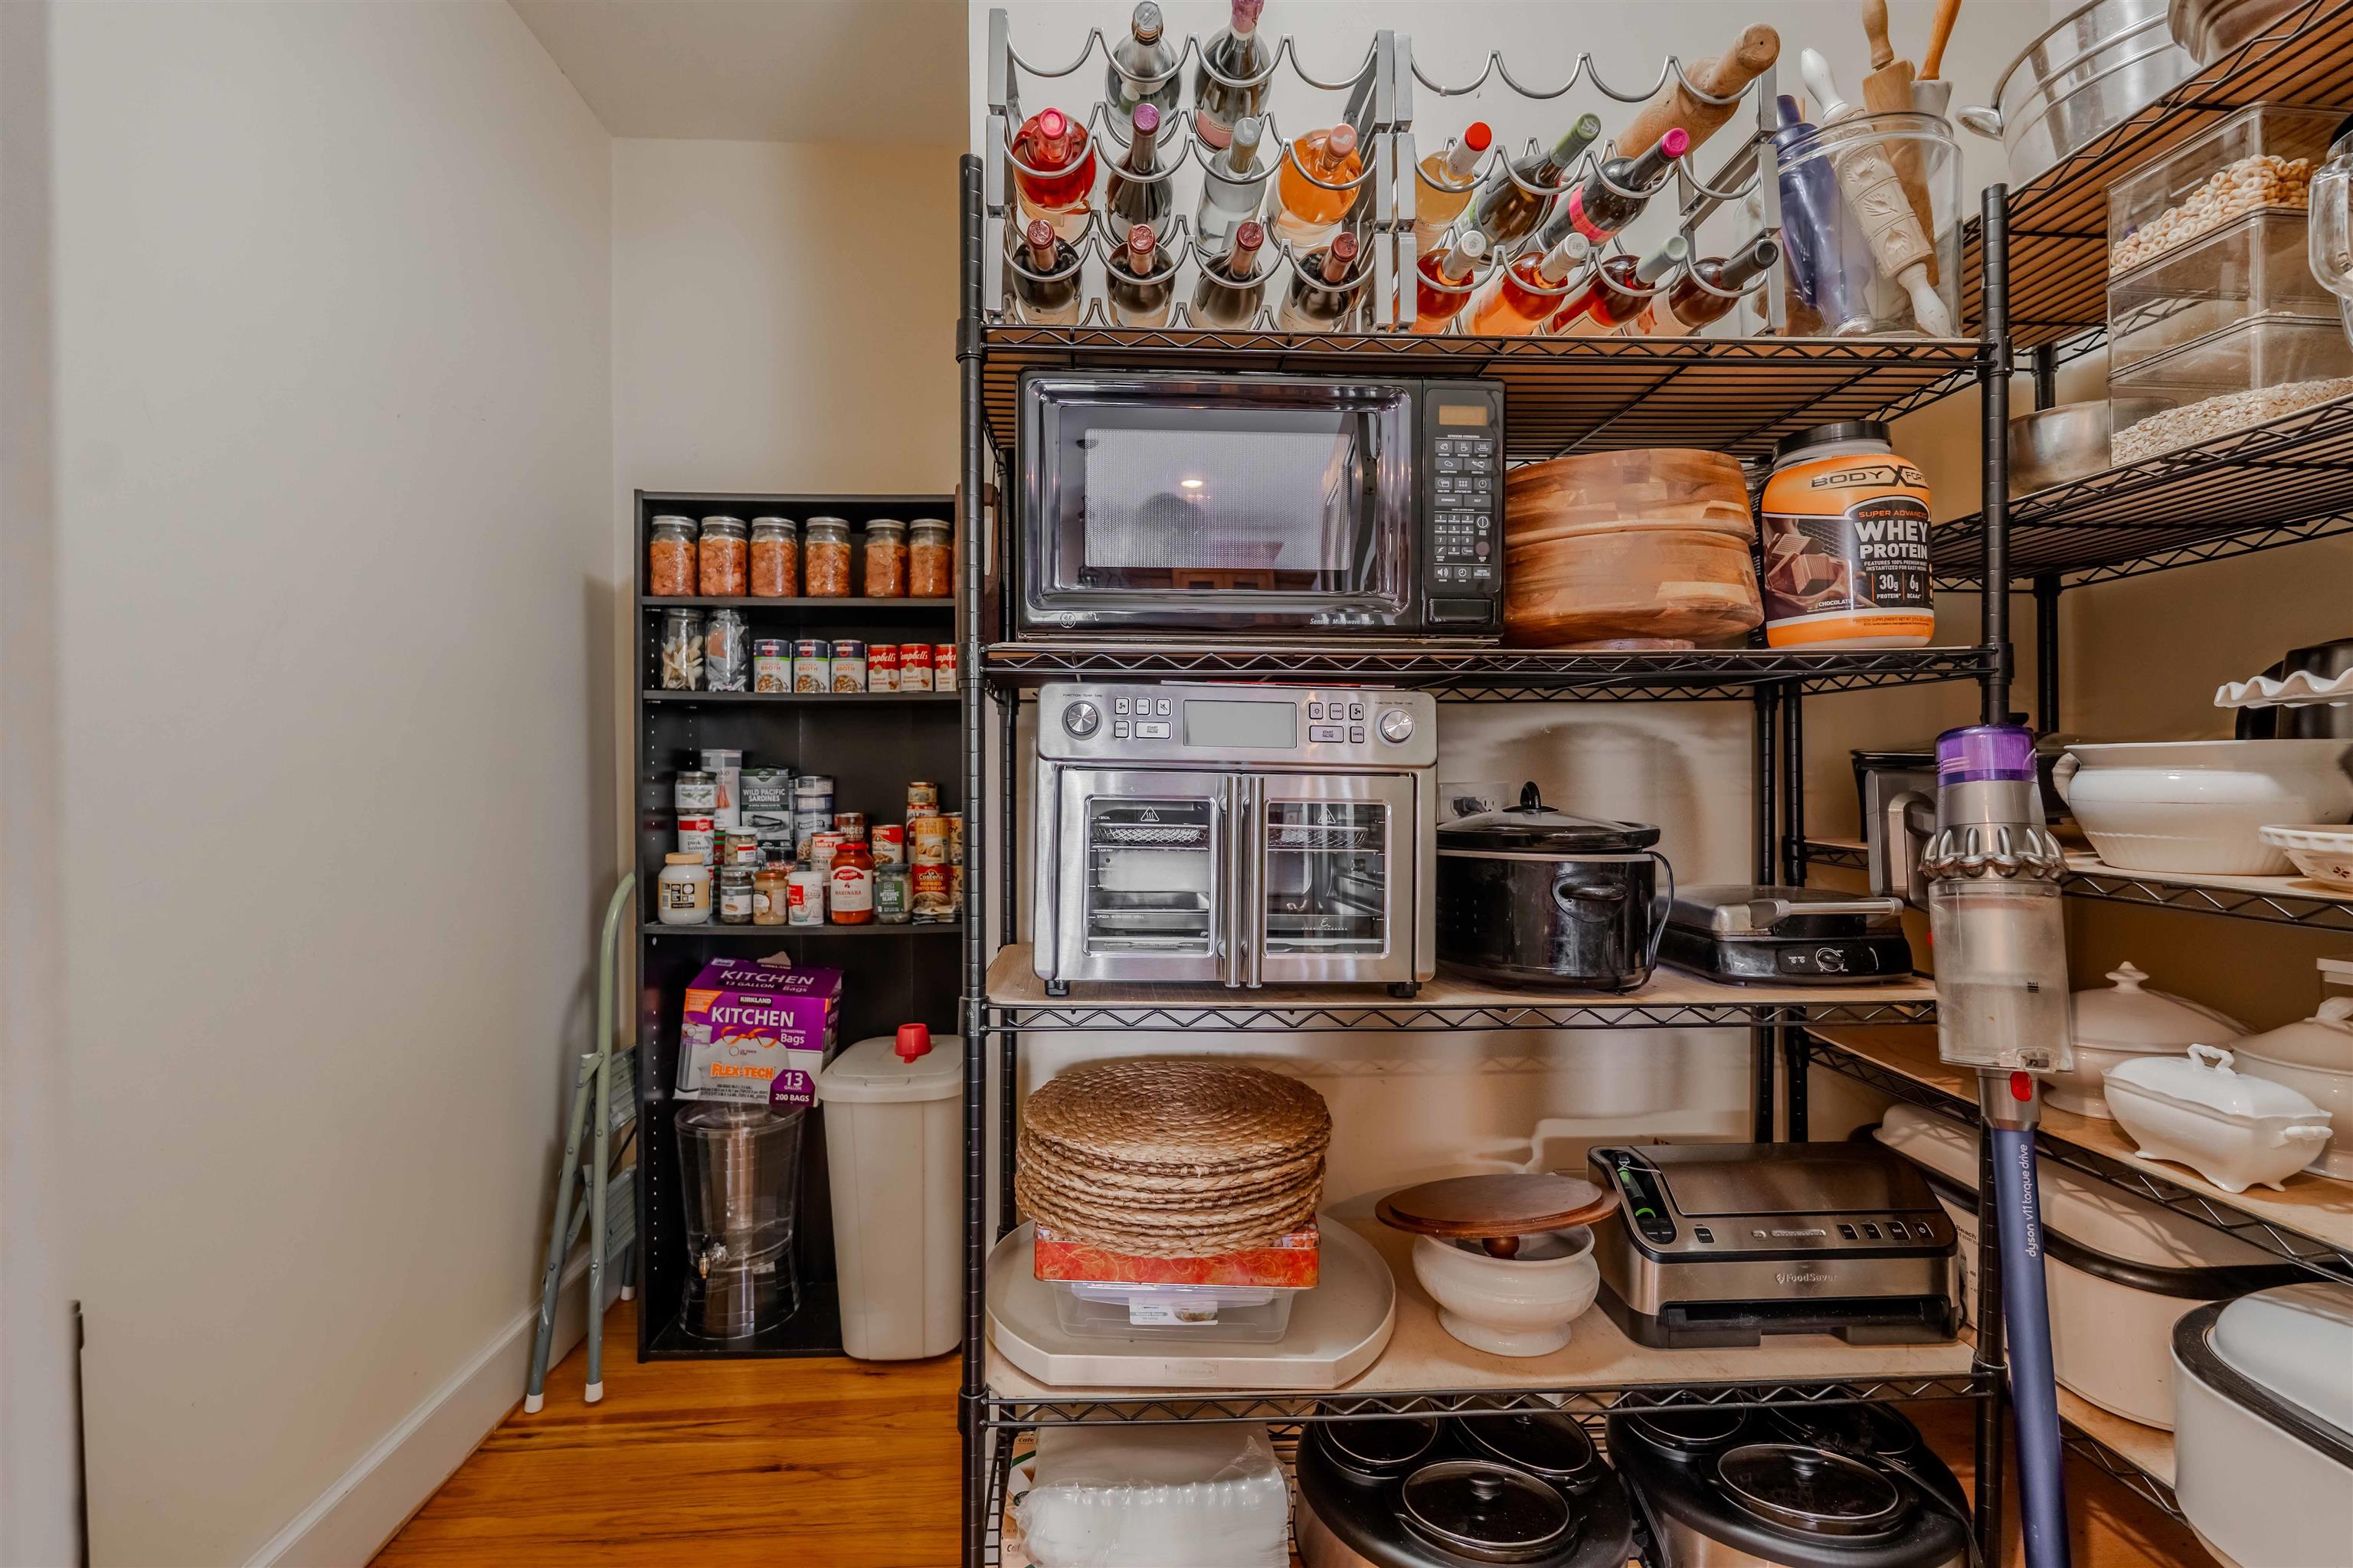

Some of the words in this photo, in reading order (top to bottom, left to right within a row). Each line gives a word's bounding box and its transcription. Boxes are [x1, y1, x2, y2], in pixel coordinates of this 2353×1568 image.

[1811, 470, 1884, 488] BODY
[1858, 510, 1890, 519] SUPER
[1893, 510, 1927, 519] ADVANCED
[1854, 519, 1928, 542] WHEY
[1860, 543, 1928, 560] PROTEIN
[1879, 574, 1899, 591] 30g
[1910, 574, 1919, 592] 6g
[720, 970, 814, 986] KITCHEN
[740, 996, 772, 1004] KIRKLAND
[711, 1006, 795, 1028] KITCHEN
[780, 1033, 805, 1045] Bags
[784, 1072, 804, 1087] 13
[775, 1093, 789, 1102] 200
[790, 1094, 810, 1102] BAGS
[2019, 1144, 2030, 1170] drive
[2021, 1170, 2033, 1204] torque
[2022, 1205, 2034, 1220] v11
[1955, 1225, 1976, 1240] Beach
[2025, 1223, 2039, 1257] dyson
[1785, 1273, 1838, 1282] FoodSaver
[1006, 1543, 1021, 1553] Caf
